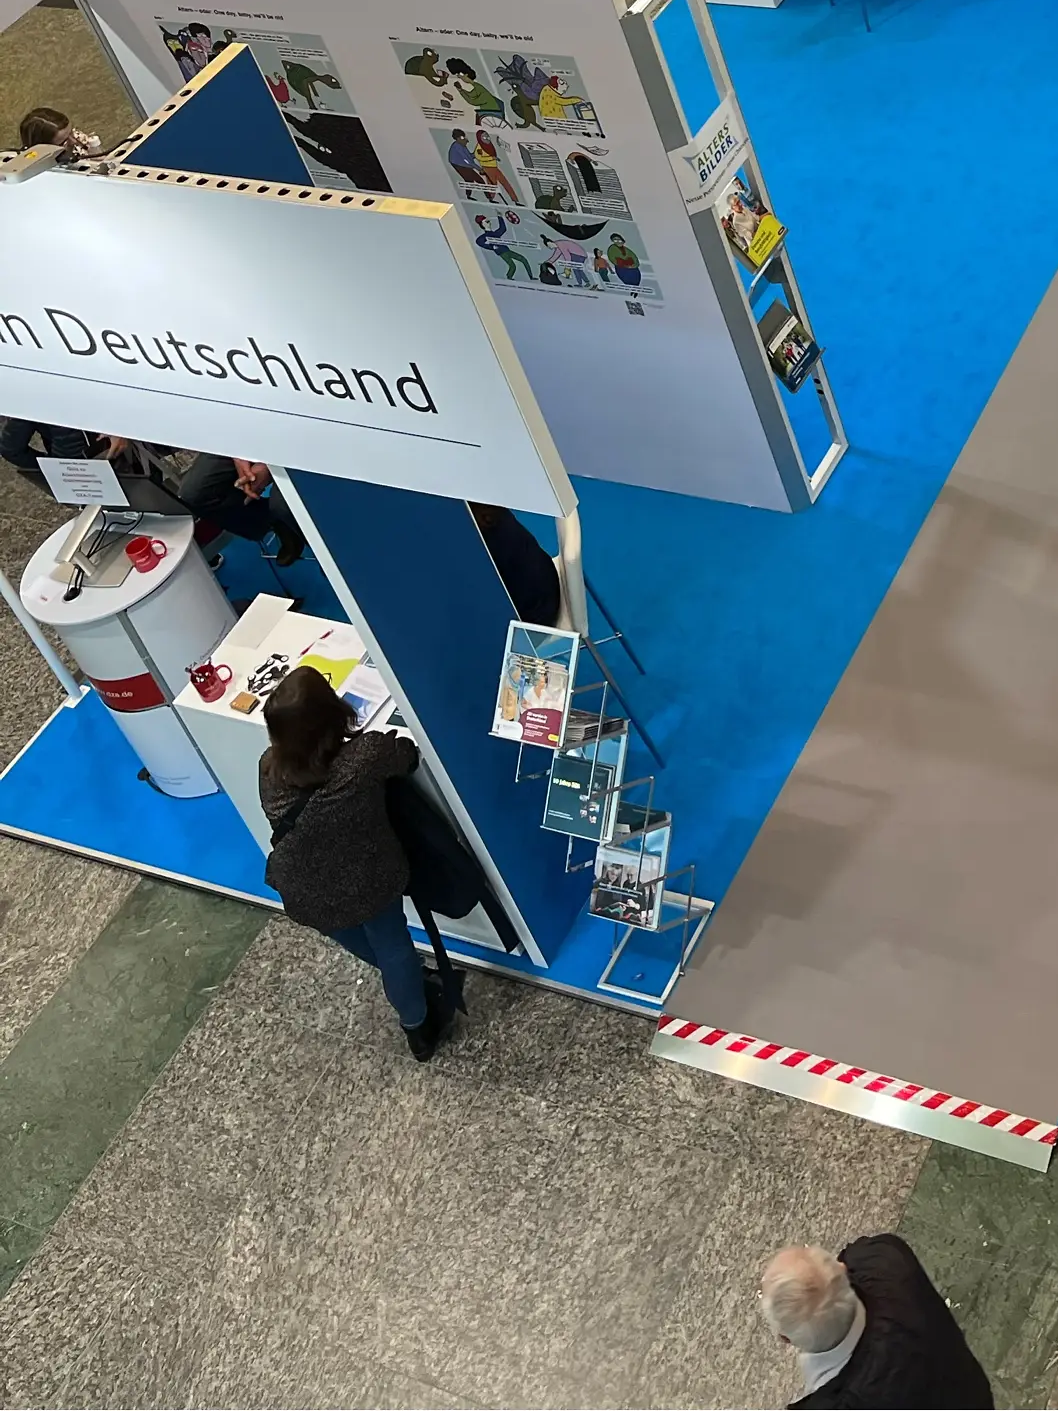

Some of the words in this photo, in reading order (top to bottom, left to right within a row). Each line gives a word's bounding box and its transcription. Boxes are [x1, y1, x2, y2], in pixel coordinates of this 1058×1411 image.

[697, 122, 729, 170] ALTERS
[699, 134, 733, 182] BILDER
[685, 193, 703, 204] Neue
[44, 307, 438, 414] Deutschland
